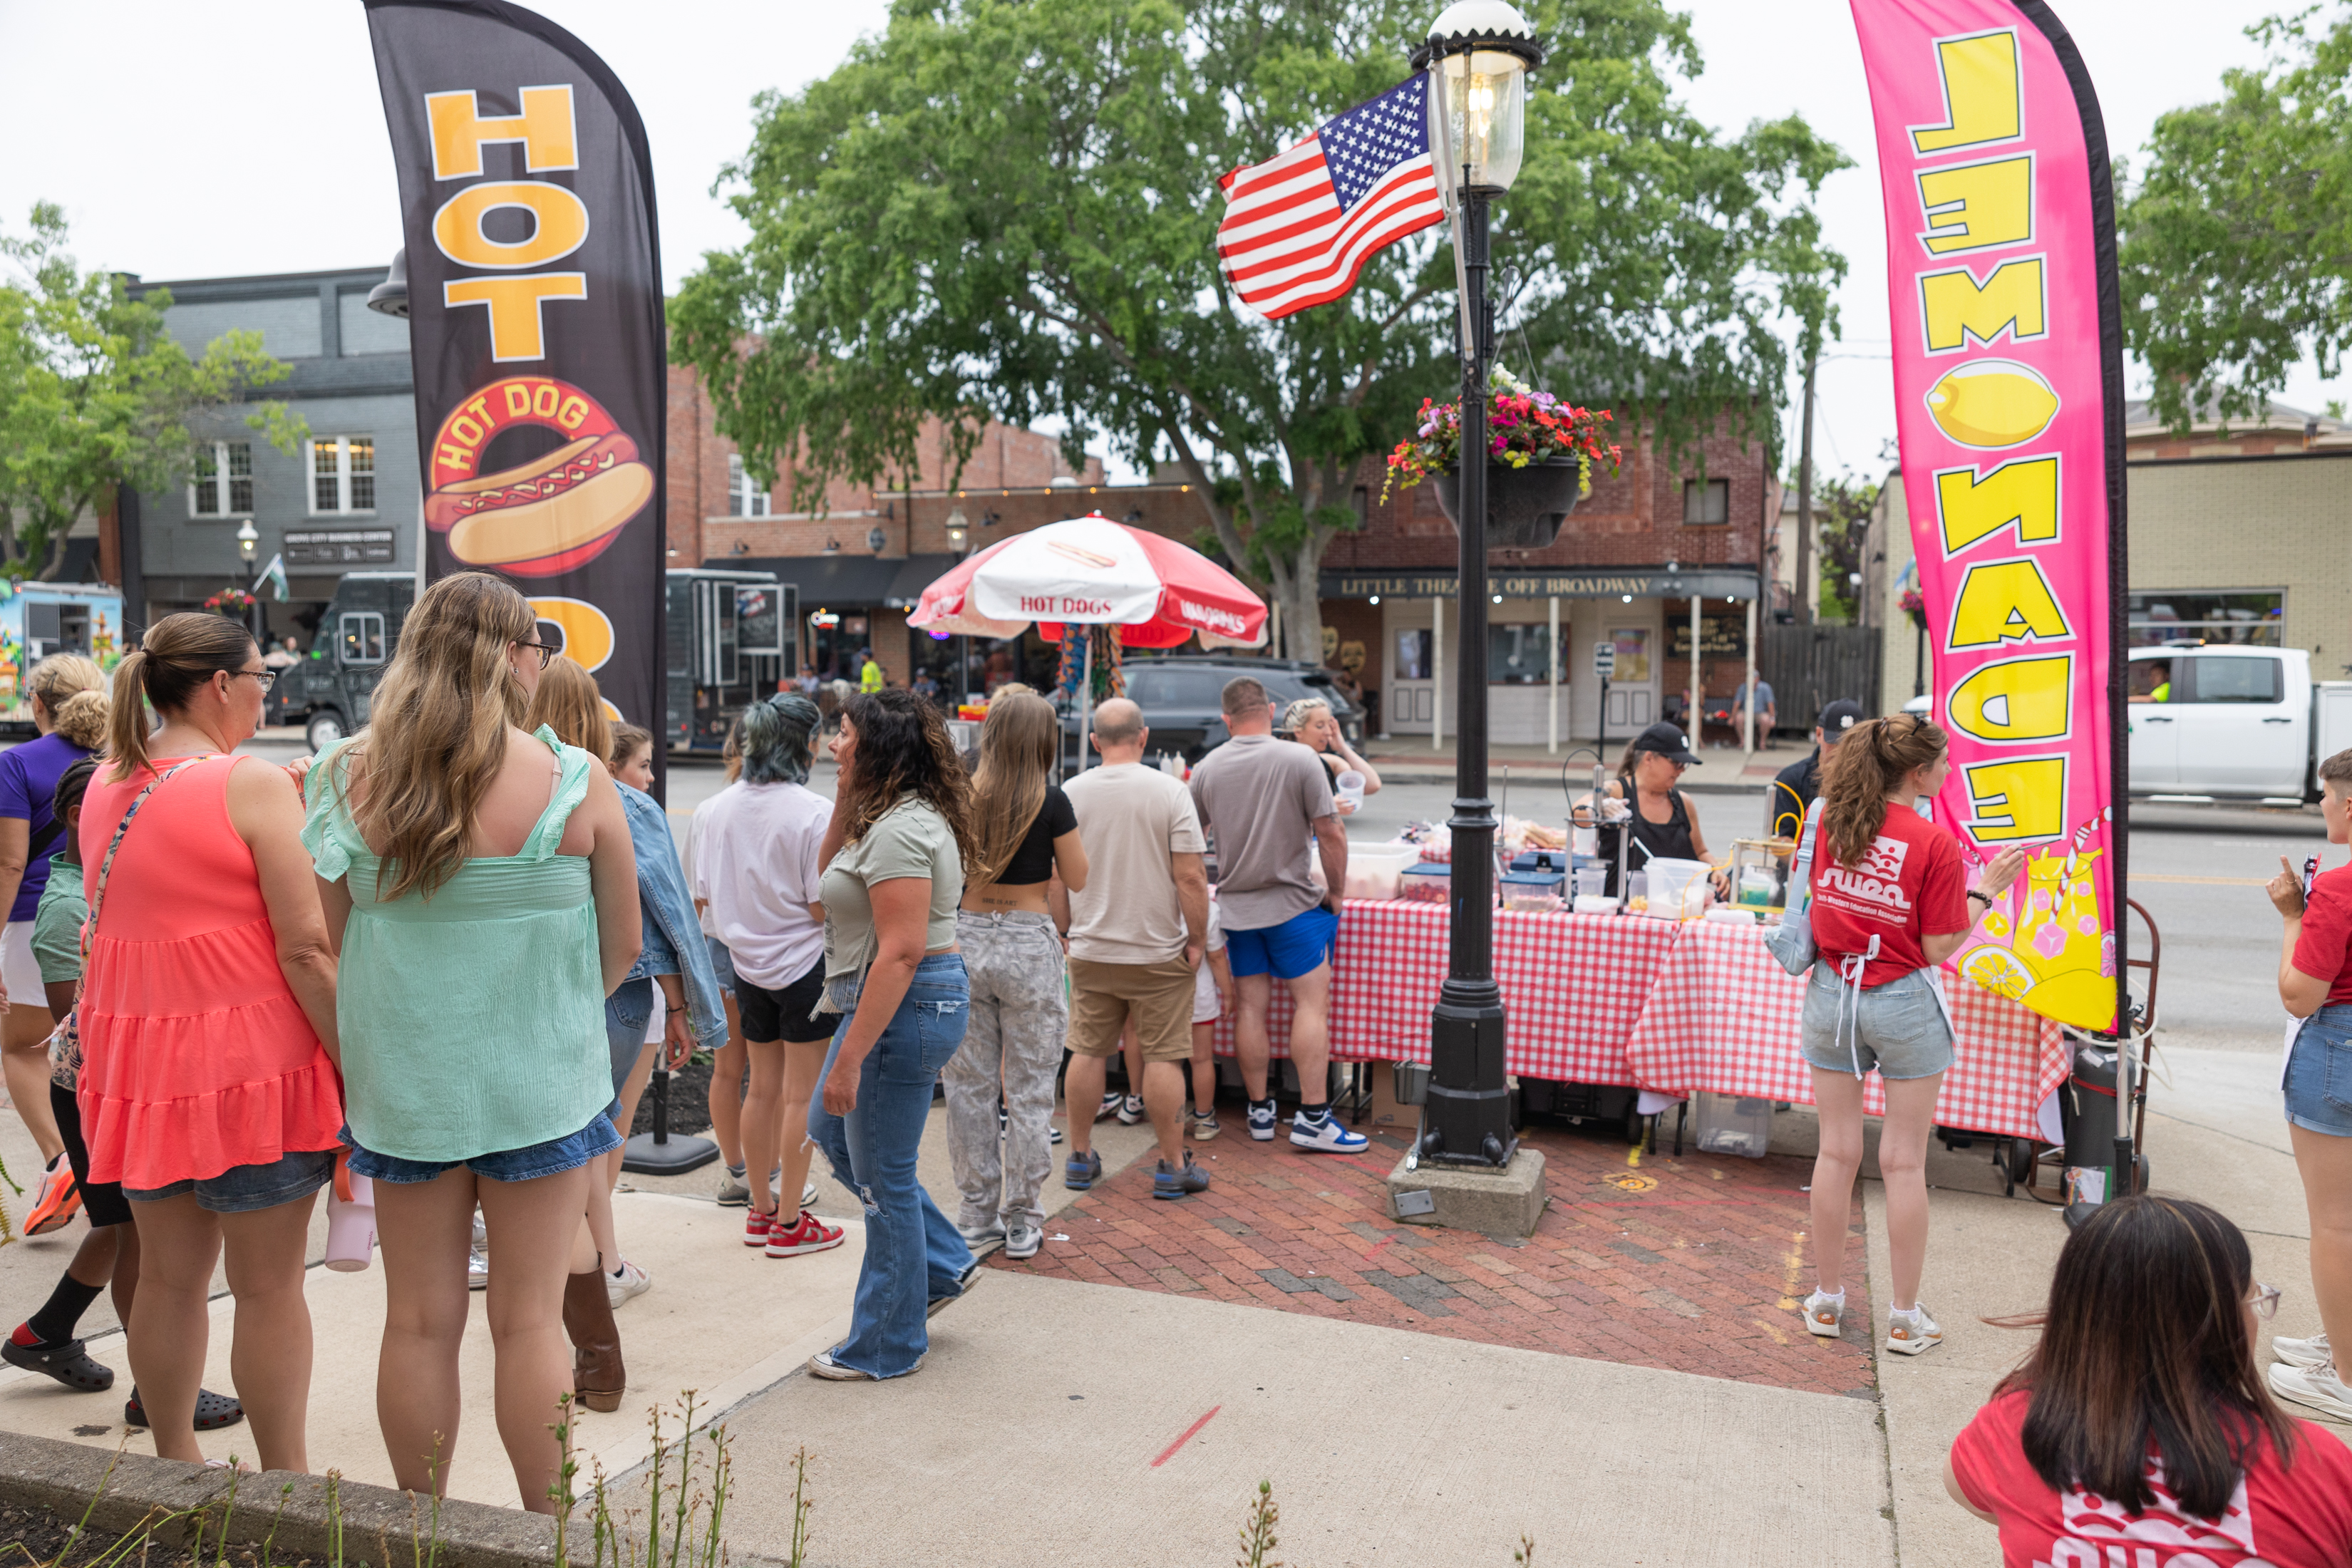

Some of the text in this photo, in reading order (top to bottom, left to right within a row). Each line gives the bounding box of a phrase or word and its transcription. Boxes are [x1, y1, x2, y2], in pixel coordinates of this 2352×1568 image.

[424, 83, 589, 363] HOT
[438, 383, 589, 471] HOT DOG
[1341, 577, 1651, 594] LITTLE THEAE OFF BROADWAY
[1021, 595, 1112, 615] HOT DOGS
[1850, 902, 1877, 915] Education
[1877, 909, 1908, 924] Association
